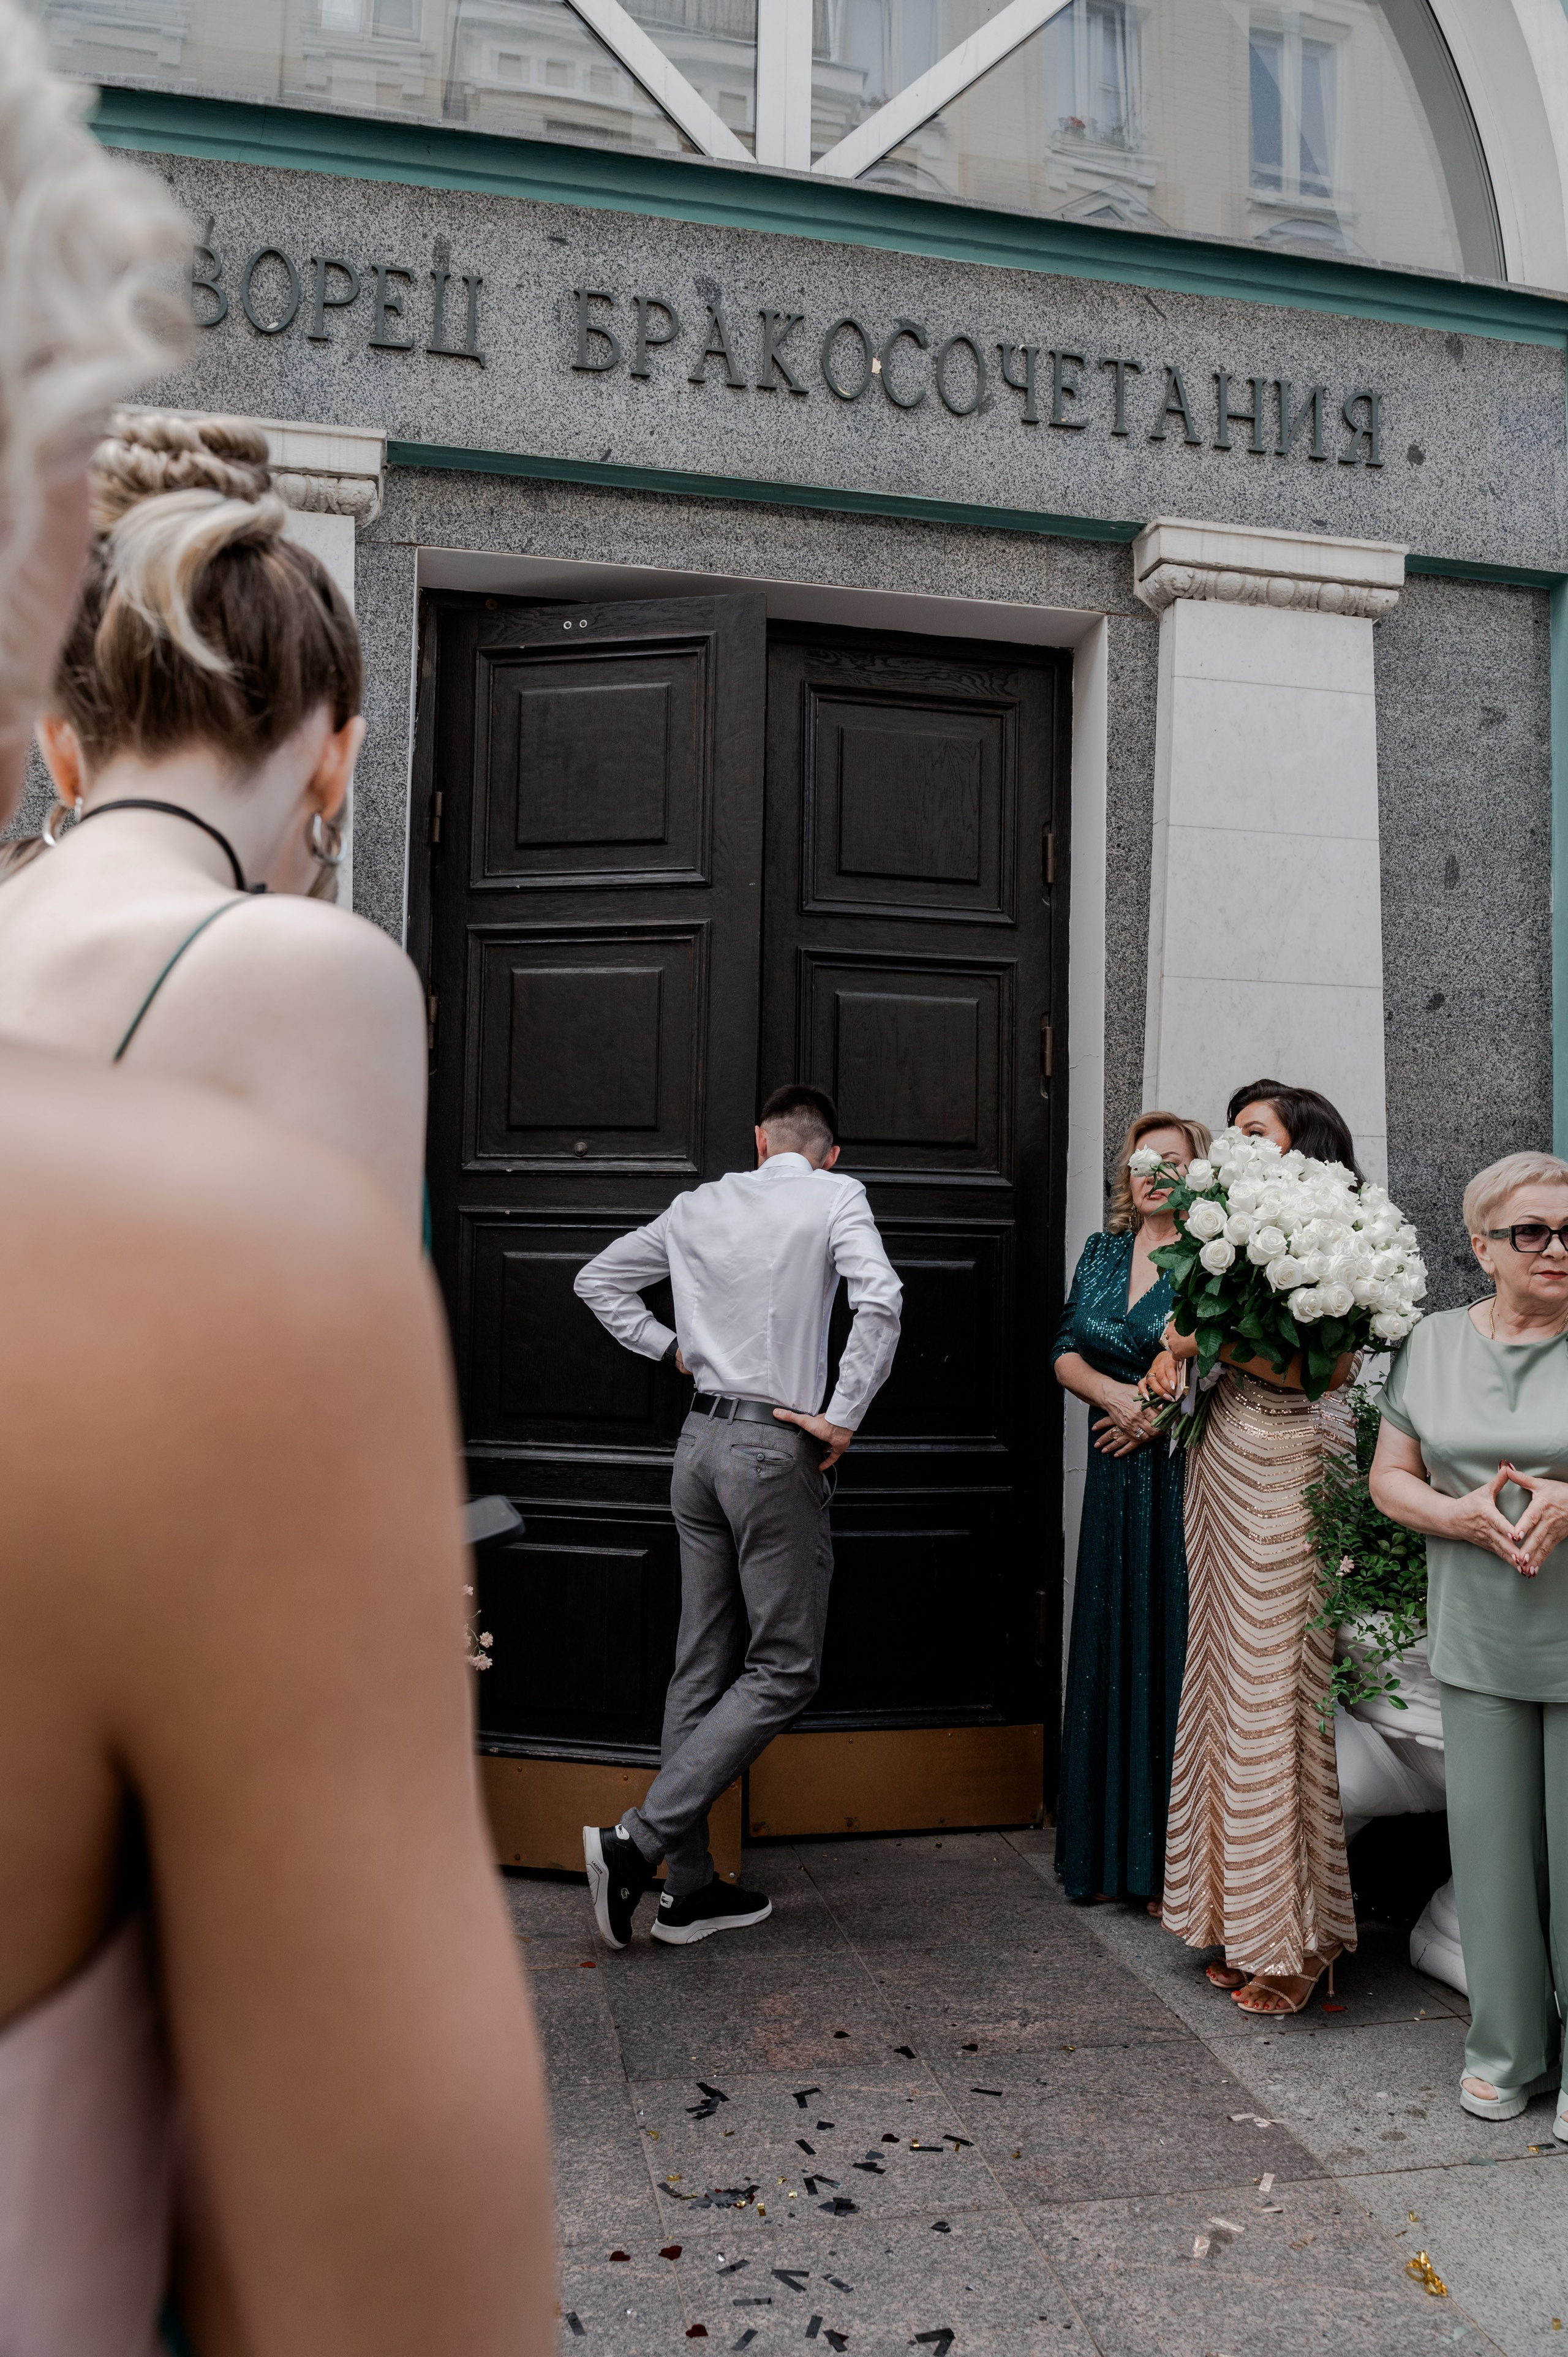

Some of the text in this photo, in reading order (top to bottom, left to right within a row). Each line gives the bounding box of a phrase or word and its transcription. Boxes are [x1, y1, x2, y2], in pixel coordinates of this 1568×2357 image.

[186, 245, 1384, 467] ВОРЕЦ БРАКОСОЧЕТАНИЯ
[591, 1860, 603, 1874] LACOSTE
